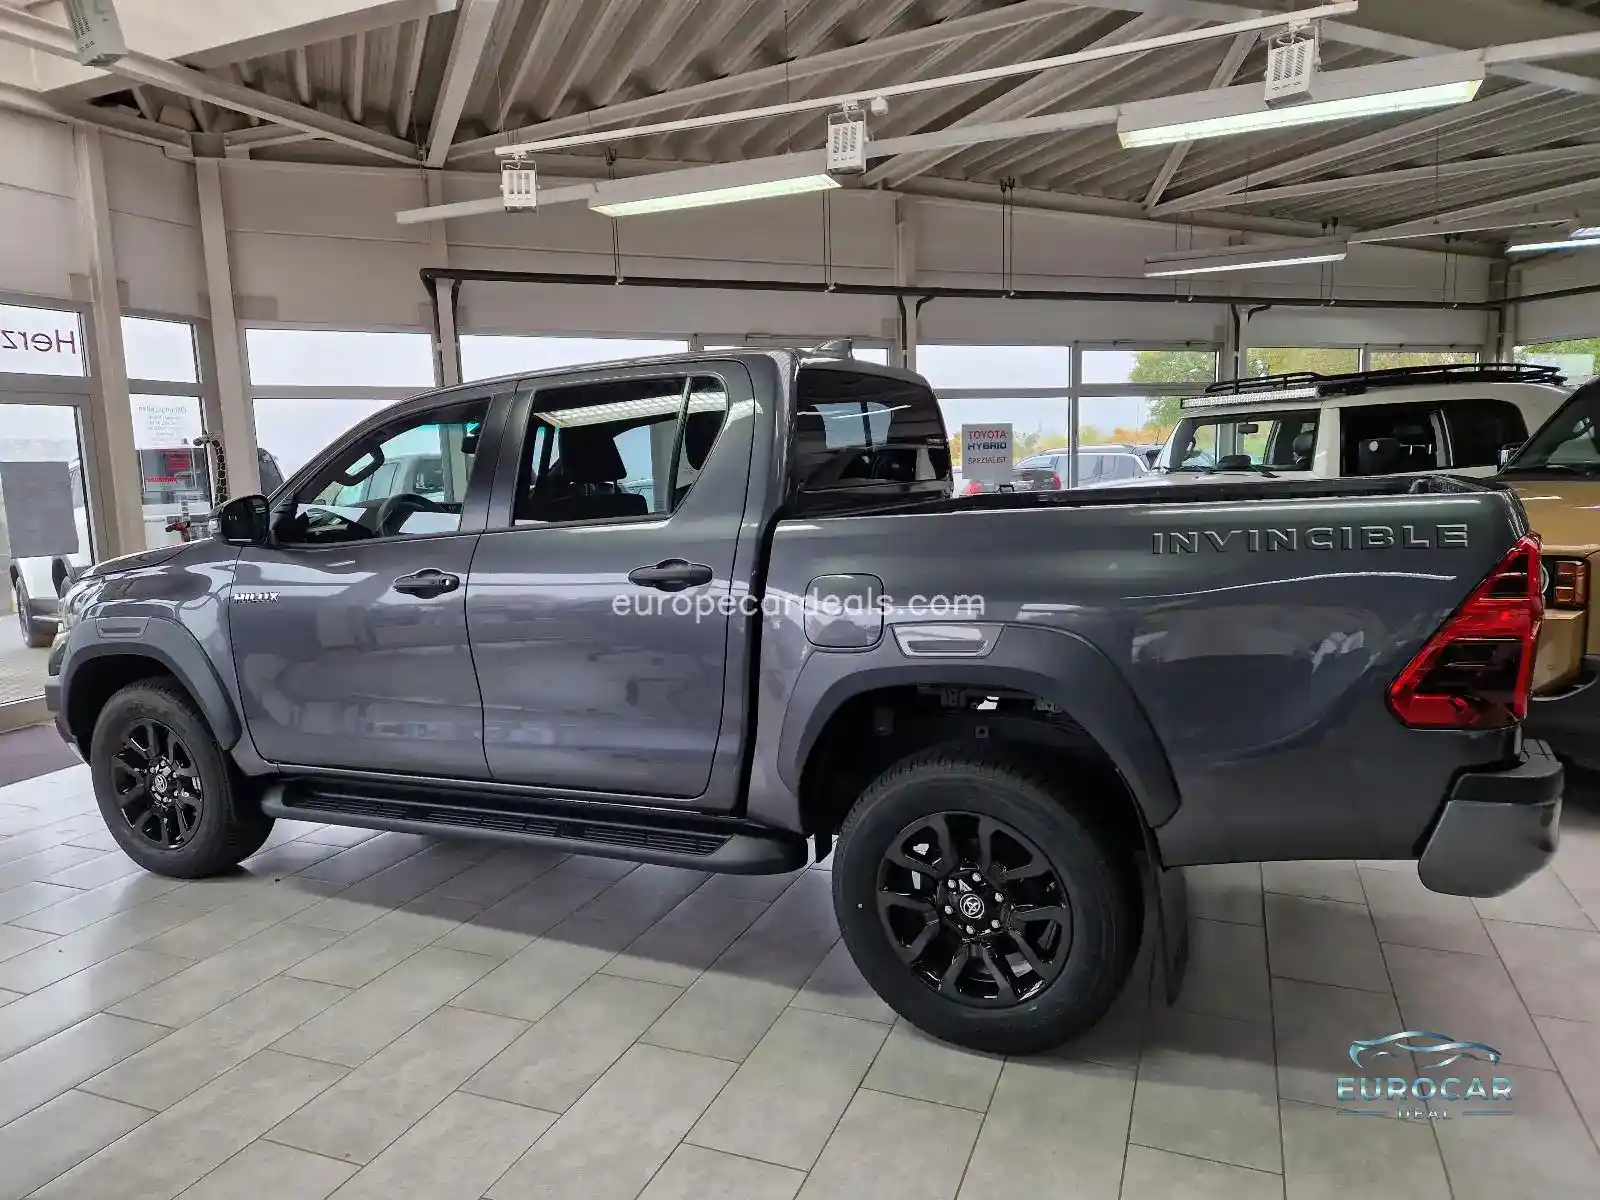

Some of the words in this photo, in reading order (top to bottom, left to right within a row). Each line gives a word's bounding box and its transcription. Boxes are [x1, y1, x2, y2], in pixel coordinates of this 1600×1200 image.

[968, 430, 1008, 440] TOYOTA
[967, 441, 1007, 450] HYBRID
[968, 456, 1007, 464] SPEZIALIST
[1152, 523, 1469, 555] INVINCIBLE
[233, 591, 280, 604] HILUX
